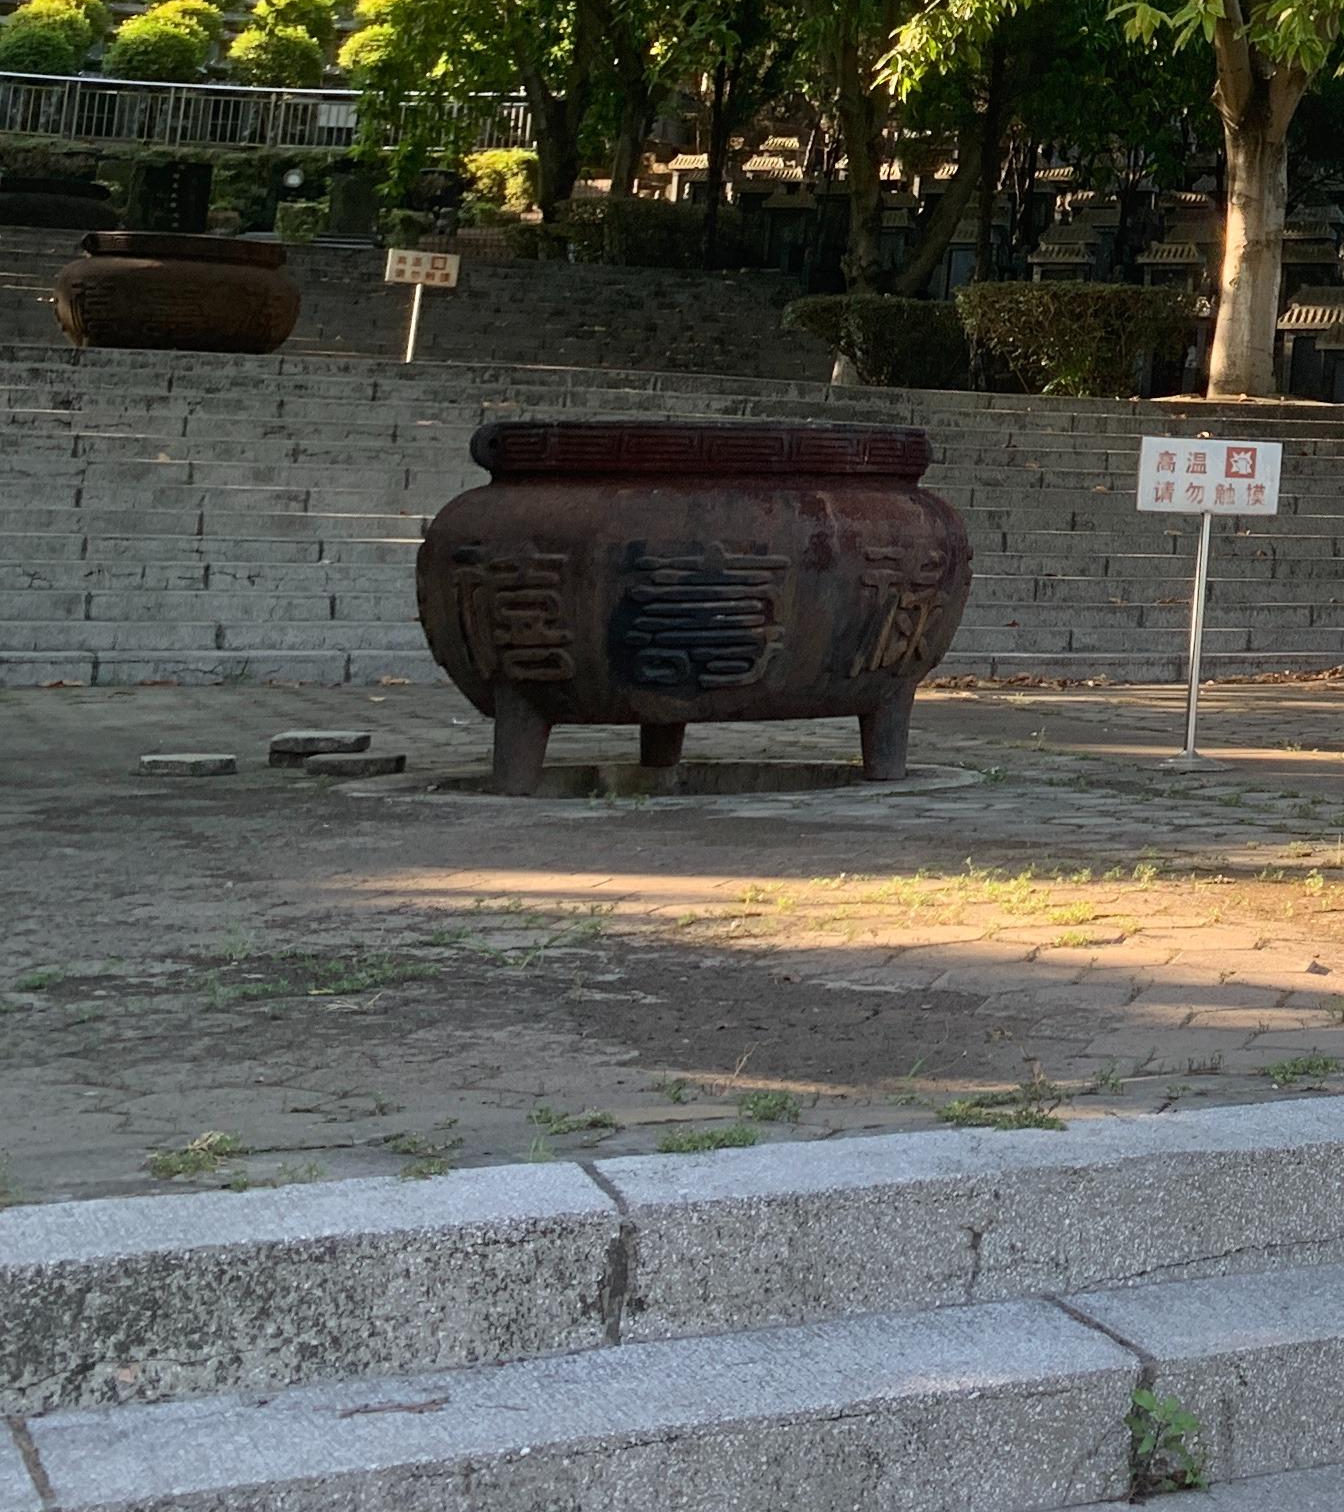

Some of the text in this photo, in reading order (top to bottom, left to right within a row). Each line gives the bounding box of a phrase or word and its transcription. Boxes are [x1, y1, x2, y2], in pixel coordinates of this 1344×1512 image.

[1156, 450, 1207, 474] 高温
[1154, 481, 1266, 506] 请勿触摸
